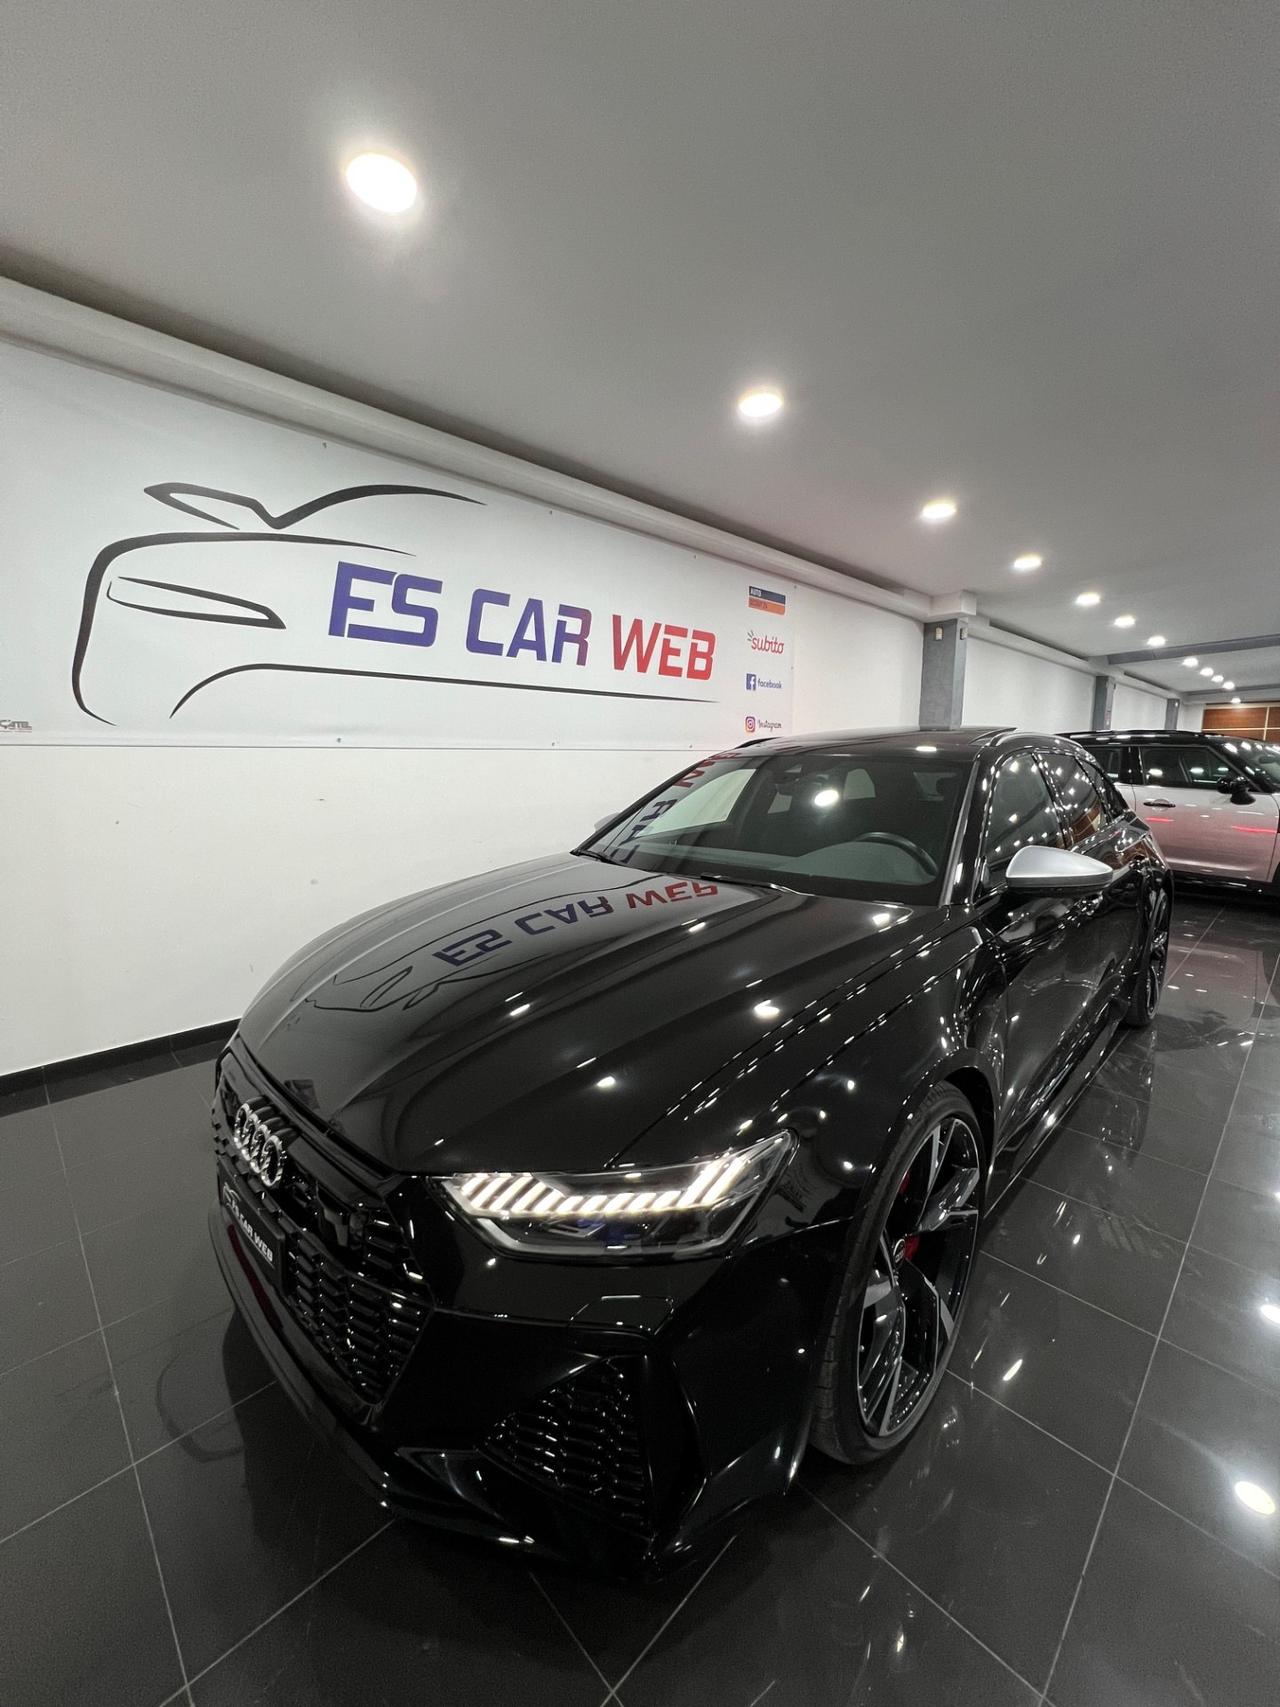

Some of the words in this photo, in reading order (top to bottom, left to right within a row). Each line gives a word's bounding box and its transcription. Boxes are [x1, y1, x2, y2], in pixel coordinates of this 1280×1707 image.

[328, 561, 443, 648] ES
[465, 588, 593, 667] CAR
[611, 614, 717, 681] WEB
[751, 635, 785, 655] subito
[757, 678, 782, 689] facebook
[757, 719, 782, 732] Instagram
